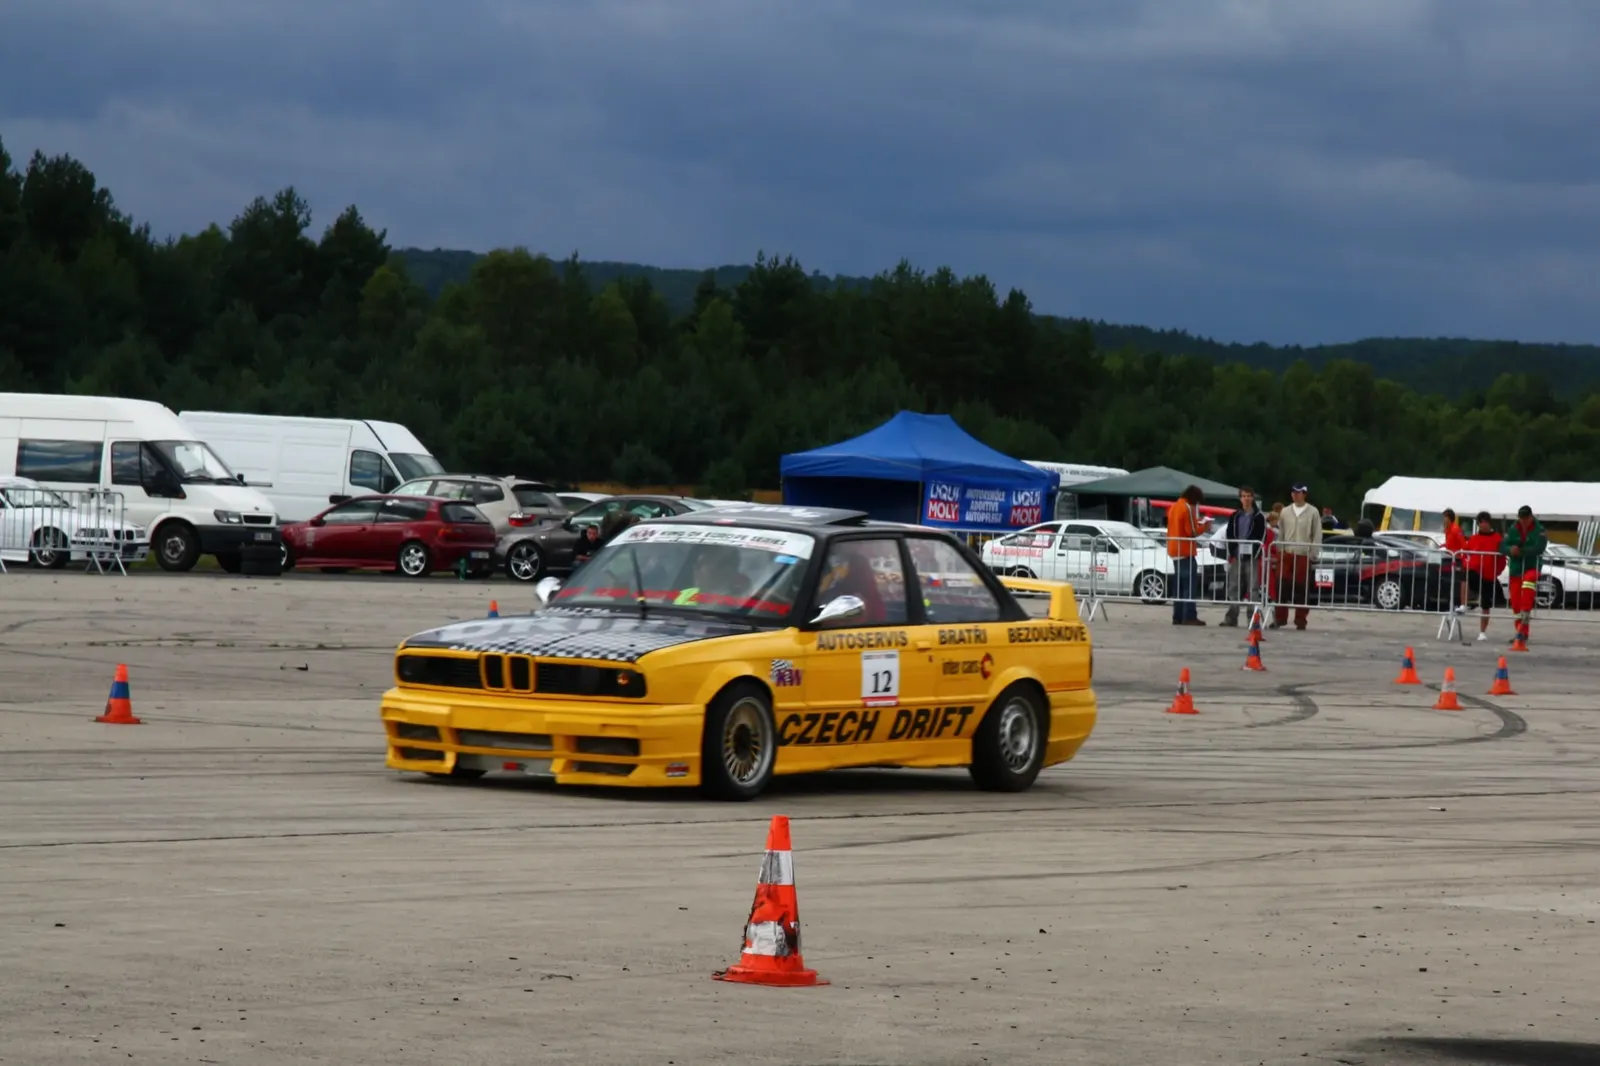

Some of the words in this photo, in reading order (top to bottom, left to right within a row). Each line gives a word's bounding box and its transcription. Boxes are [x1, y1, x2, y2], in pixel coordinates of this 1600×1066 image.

[930, 482, 959, 502] LIQUI
[1012, 490, 1041, 506] LIQUI
[928, 502, 959, 519] MOLY
[1010, 508, 1040, 523] MOLY
[816, 630, 909, 651] AUTOSERVIS
[937, 625, 988, 645] BRATŘI
[871, 669, 893, 694] 12
[778, 709, 881, 746] CZECH
[888, 705, 975, 740] DRIFT
